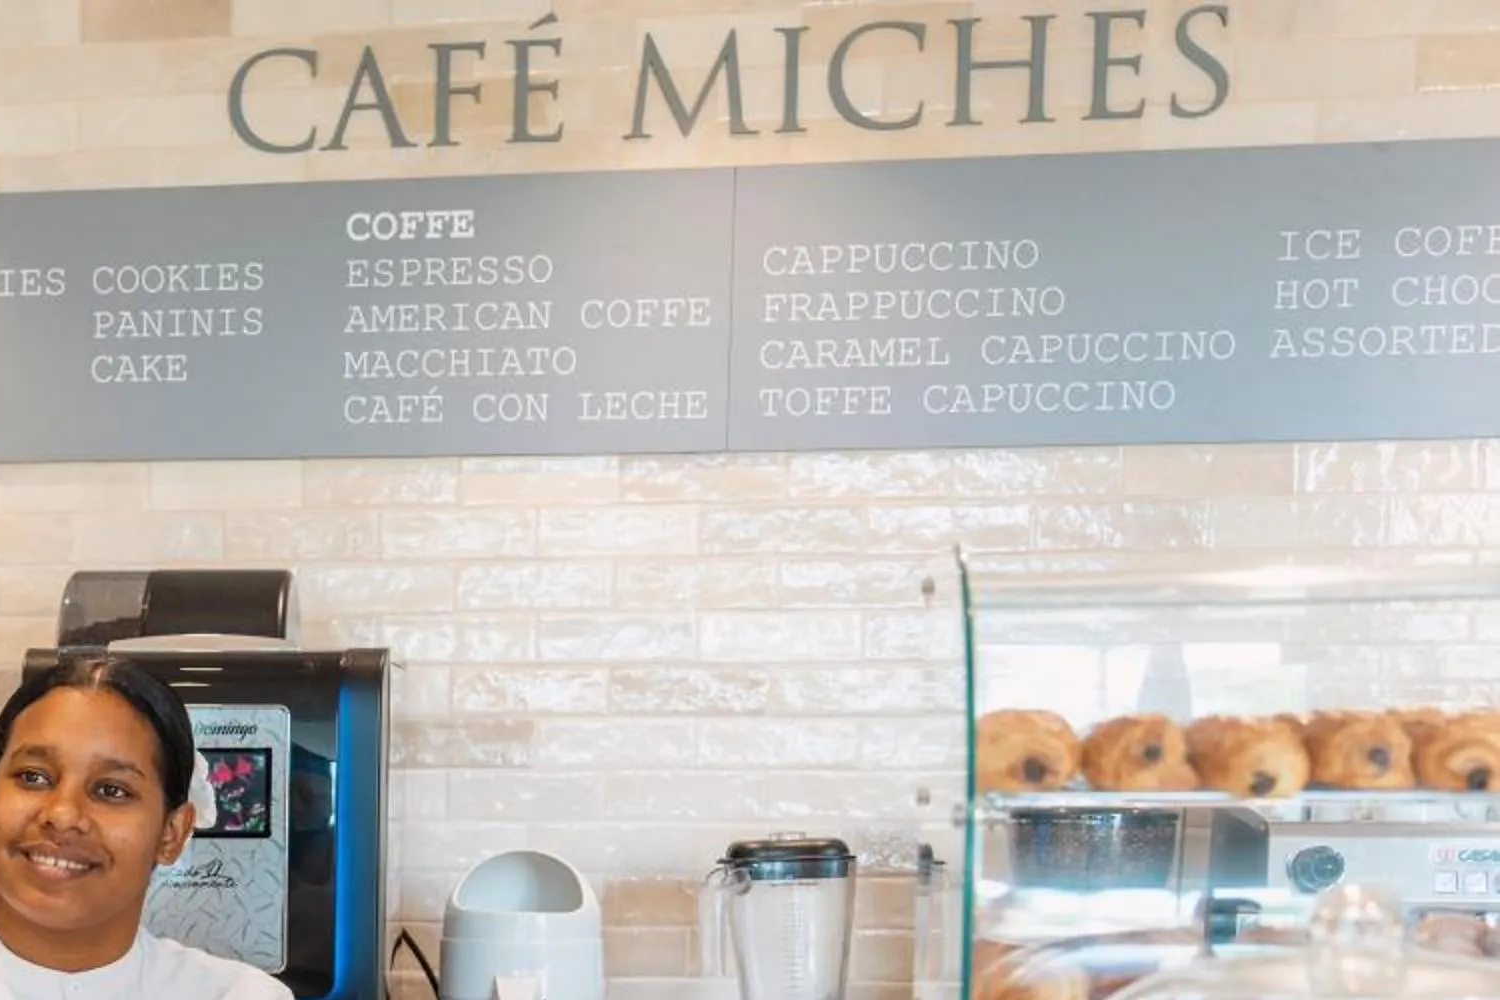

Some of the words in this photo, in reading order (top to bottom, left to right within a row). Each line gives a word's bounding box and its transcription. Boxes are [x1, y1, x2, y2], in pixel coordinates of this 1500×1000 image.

[228, 13, 565, 153] CAFÉ
[623, 4, 1230, 140] MICHES
[346, 209, 475, 241] COFFE
[763, 239, 1039, 275] CAPPUCCINO
[1277, 229, 1362, 260] ICE
[92, 262, 264, 294] COOKIES
[346, 255, 553, 288] ESPRESSO
[763, 286, 1065, 322] FRAPPUCCINO
[1274, 278, 1358, 309] HOT
[93, 307, 264, 339] PANINIS
[344, 301, 552, 333] AMERICAN
[581, 298, 711, 328] COFFE
[760, 337, 949, 369] CARAMEL
[982, 330, 1235, 365] CAPUCCINO
[1270, 323, 1500, 358] ASSORTED
[91, 354, 187, 383] CAKE
[343, 347, 577, 379] MACCHIATO
[344, 386, 443, 424] CAFÉ
[473, 393, 549, 422] CON
[579, 391, 707, 421] LECHE
[759, 385, 891, 416] TOFFE
[923, 380, 1175, 414] CAPUCCINO
